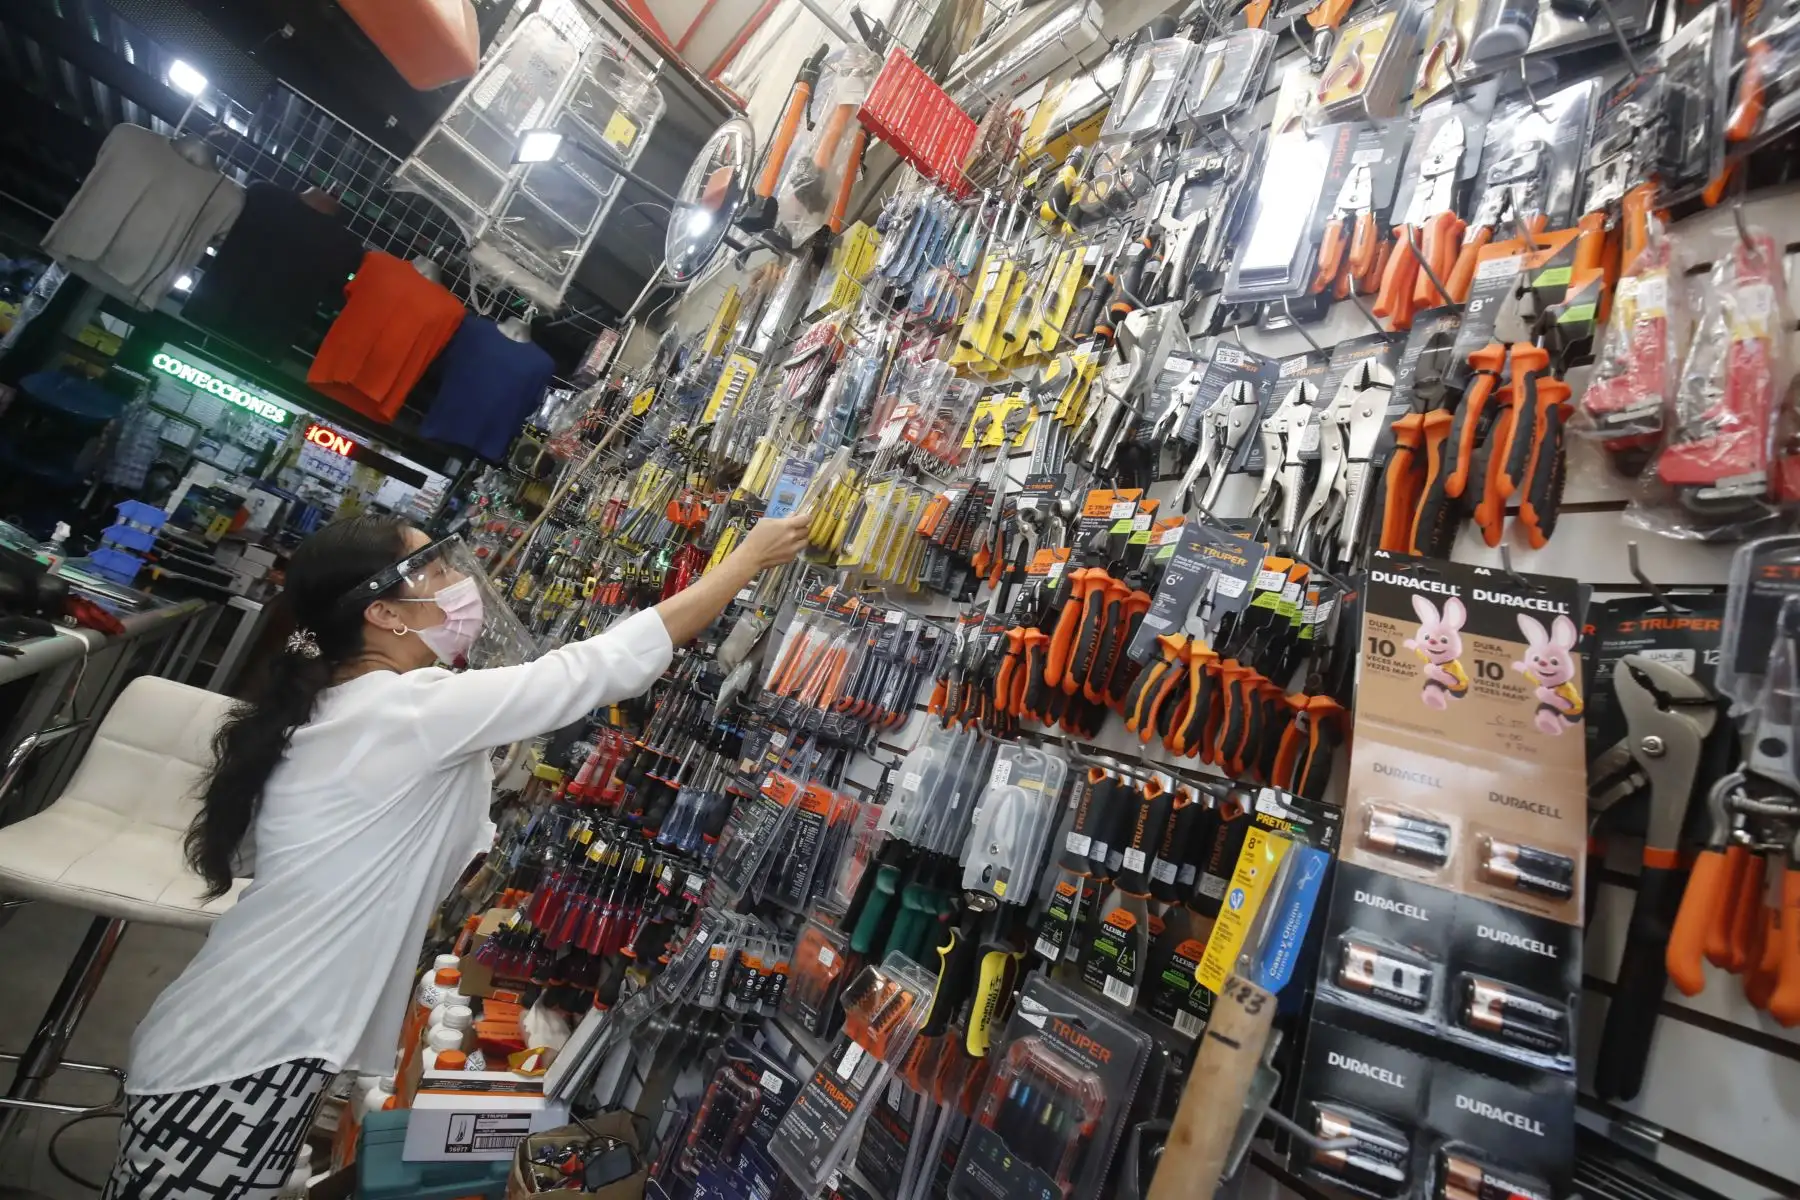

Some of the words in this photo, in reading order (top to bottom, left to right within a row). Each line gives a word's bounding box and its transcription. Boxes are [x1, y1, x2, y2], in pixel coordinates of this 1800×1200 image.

[1469, 297, 1494, 313] 8"
[152, 352, 286, 424] CONECCIONES
[1076, 531, 1091, 542] 7"
[1203, 546, 1249, 567] TRUPER
[1374, 550, 1391, 559] AA
[1165, 574, 1184, 586] 6"
[1371, 570, 1461, 597] DURACELL
[1474, 567, 1491, 576] AA
[1472, 588, 1570, 615] DURACELL
[1368, 619, 1396, 630] DURA
[1640, 617, 1722, 632] TRUPER
[1367, 636, 1396, 658] 10
[1473, 659, 1504, 681] 10
[1373, 761, 1444, 789] DURACELL
[1488, 791, 1562, 820] DURACELL
[1132, 803, 1150, 849] TRUPER
[1355, 889, 1429, 922] DURACELL
[1103, 923, 1127, 939] FLEXIBLE
[1477, 924, 1557, 959] DURACELL
[1172, 954, 1196, 970] FLEXIBL
[1052, 1017, 1112, 1064] TRUPER
[1328, 1051, 1405, 1088] DURACELL
[824, 1079, 857, 1113] TRUPER
[1455, 1093, 1545, 1136] DURACELL
